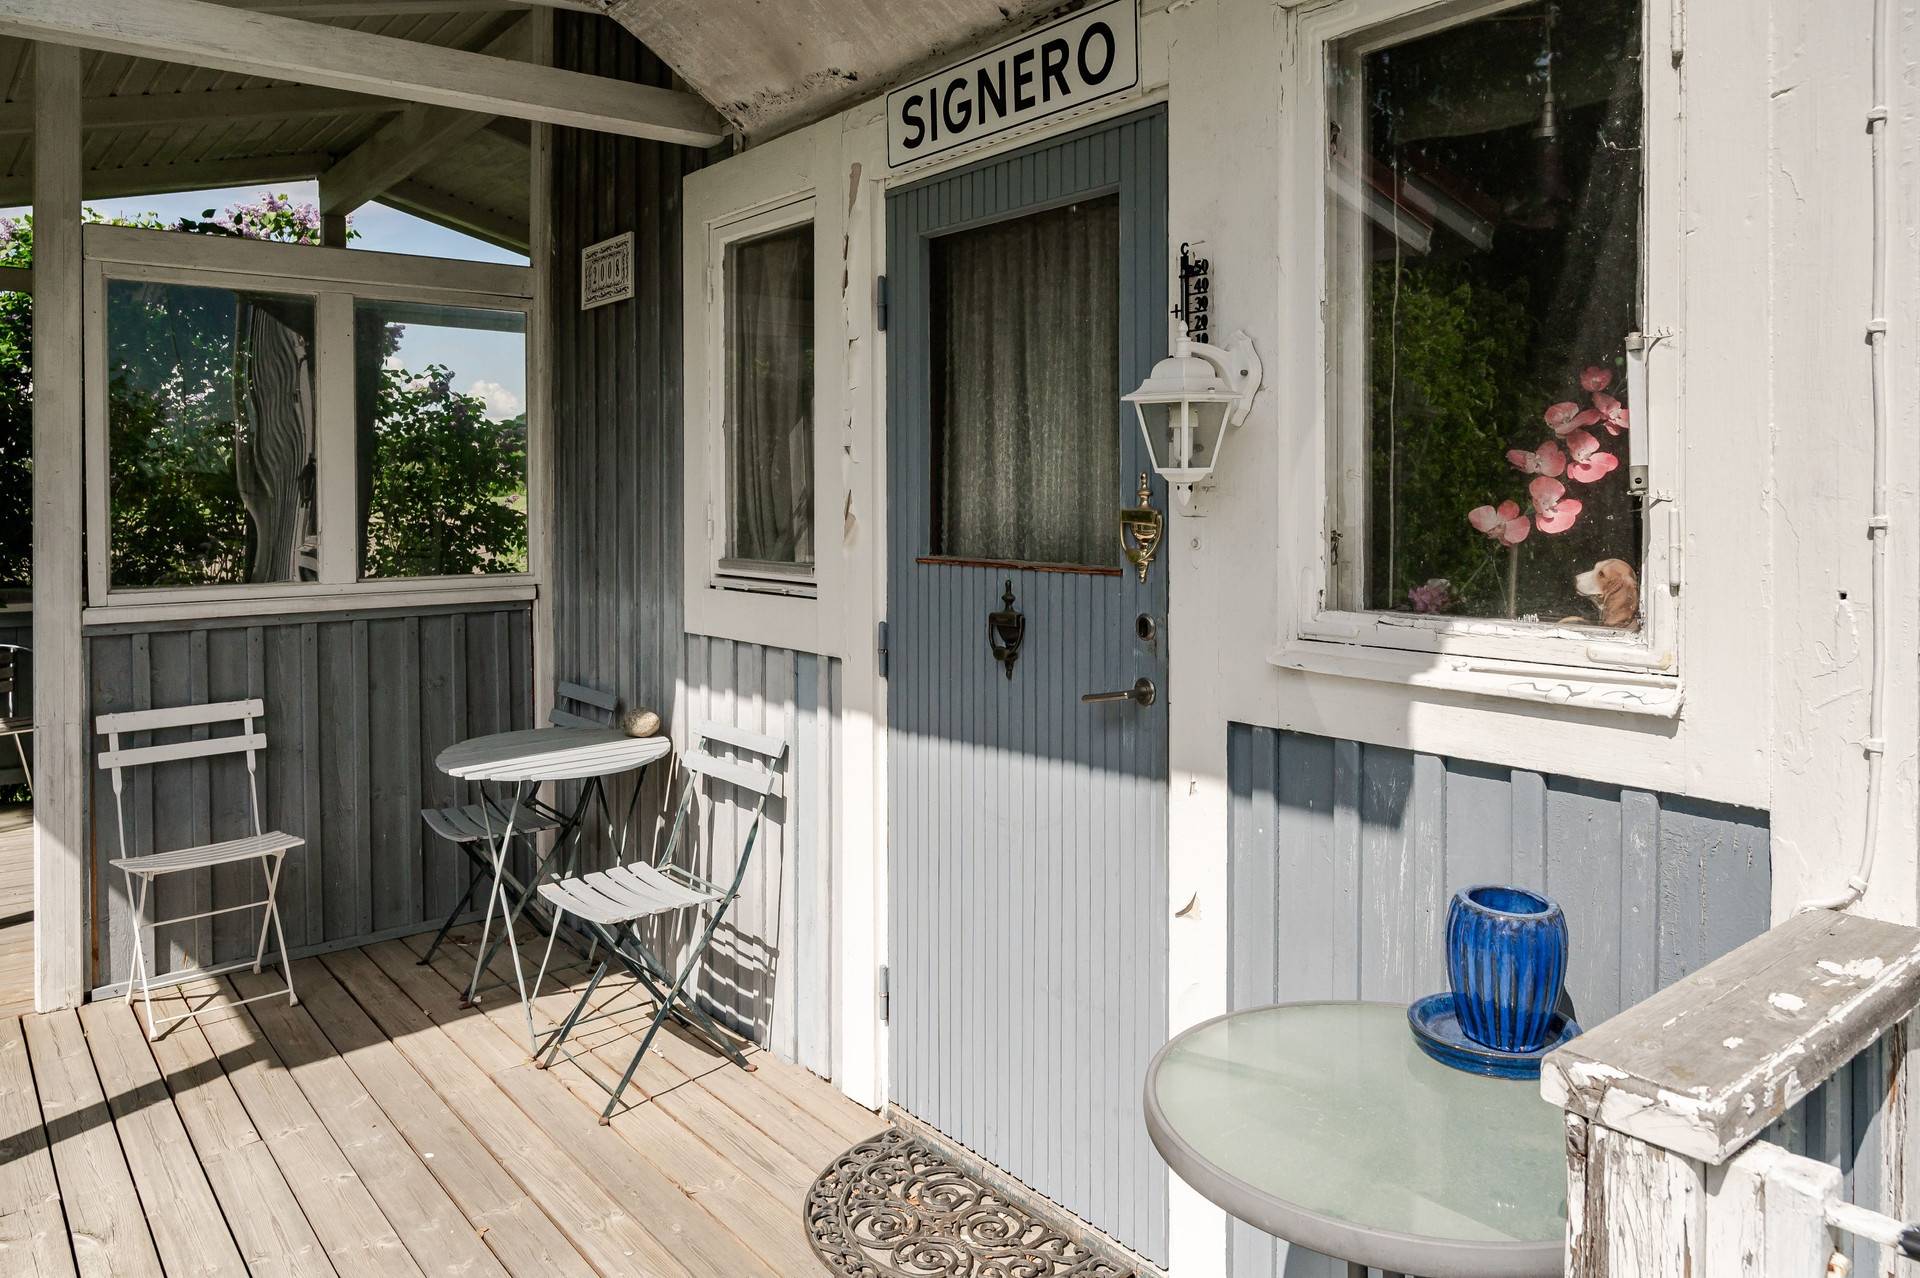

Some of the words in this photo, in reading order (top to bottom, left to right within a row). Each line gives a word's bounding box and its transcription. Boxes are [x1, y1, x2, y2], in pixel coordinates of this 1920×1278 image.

[902, 21, 1116, 149] SIGNERO
[592, 258, 620, 285] 2008
[1194, 258, 1209, 274] 50
[1193, 277, 1210, 293] 40
[1194, 295, 1209, 311] 30
[1194, 314, 1209, 330] 20
